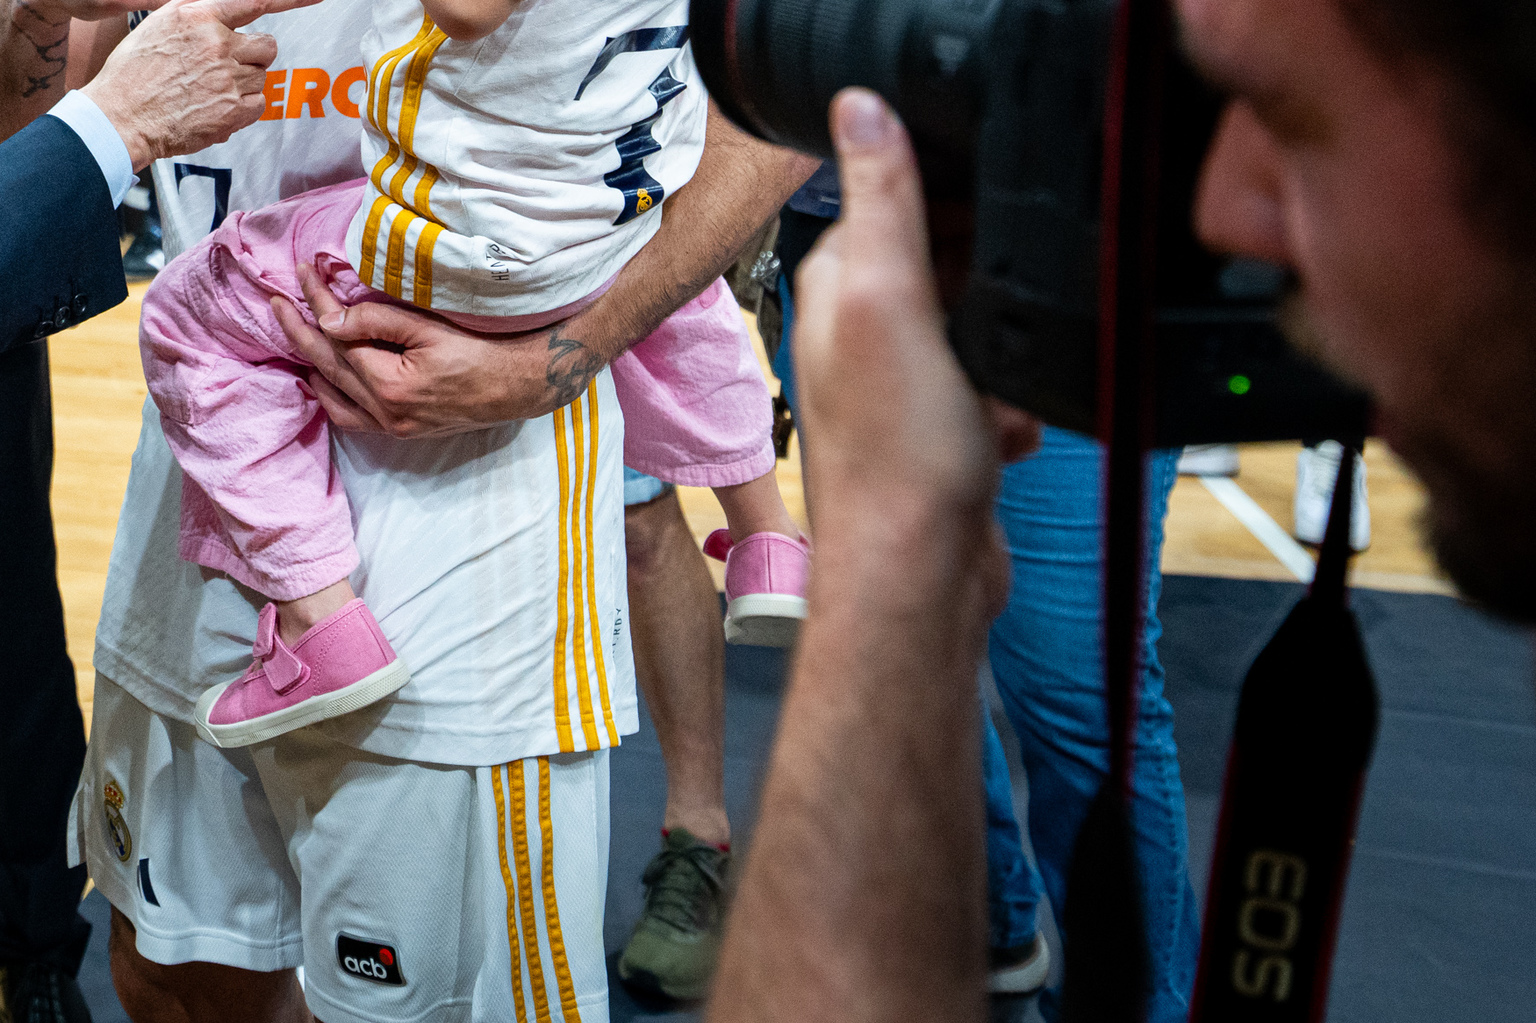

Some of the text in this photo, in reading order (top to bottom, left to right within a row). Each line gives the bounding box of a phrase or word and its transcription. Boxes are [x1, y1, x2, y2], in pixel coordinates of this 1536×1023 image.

[173, 162, 233, 235] 7
[1229, 848, 1310, 1004] EOS
[344, 956, 388, 979] acb
